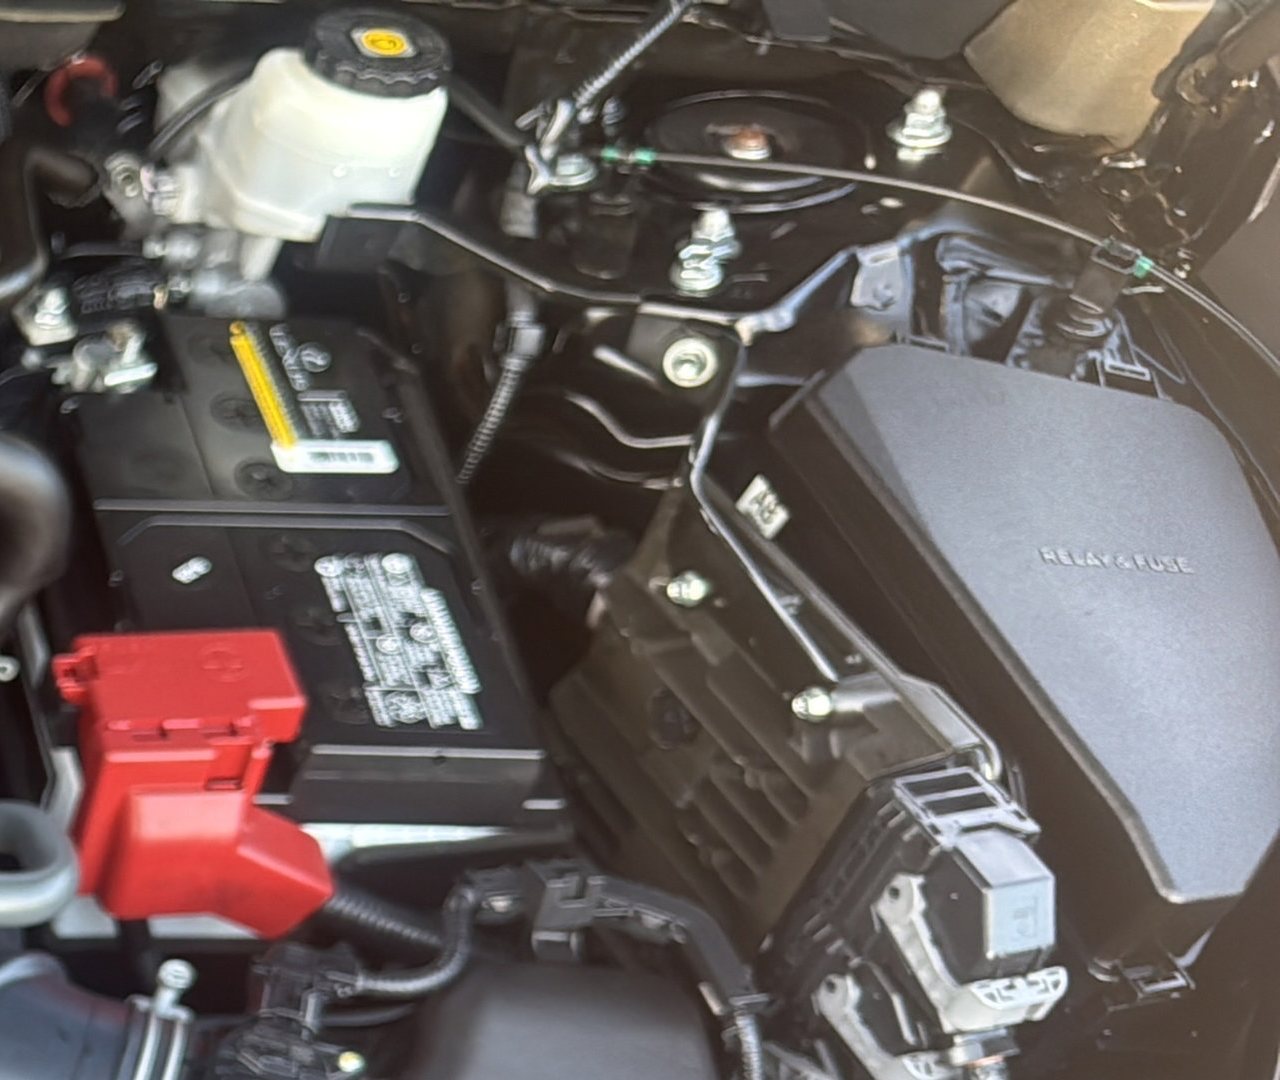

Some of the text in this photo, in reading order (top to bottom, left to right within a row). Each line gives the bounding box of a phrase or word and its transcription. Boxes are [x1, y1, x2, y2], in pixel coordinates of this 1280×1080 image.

[1038, 546, 1195, 576] RELAY & FUSE
